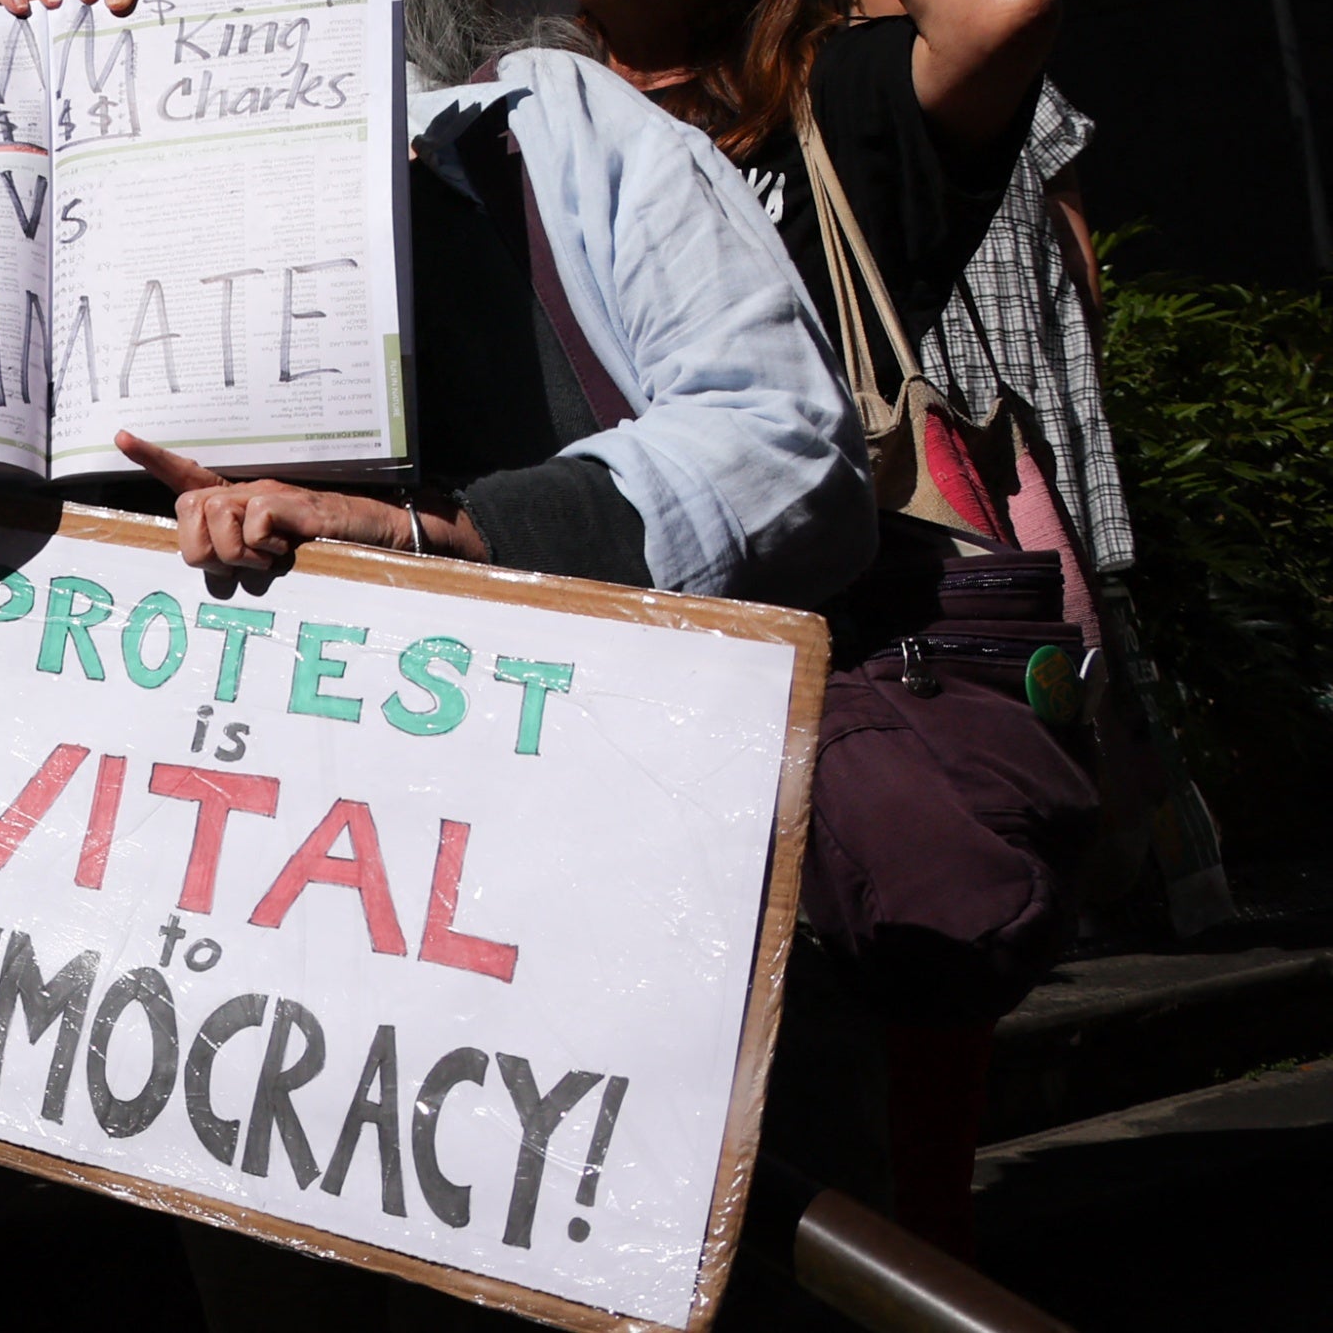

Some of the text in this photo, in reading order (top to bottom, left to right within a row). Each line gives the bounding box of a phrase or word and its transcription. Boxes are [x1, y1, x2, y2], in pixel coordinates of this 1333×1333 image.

[174, 7, 311, 78] King
[305, 430, 374, 441] PARKS FOR FAMILIES
[190, 706, 250, 761] is
[159, 914, 222, 972] to
